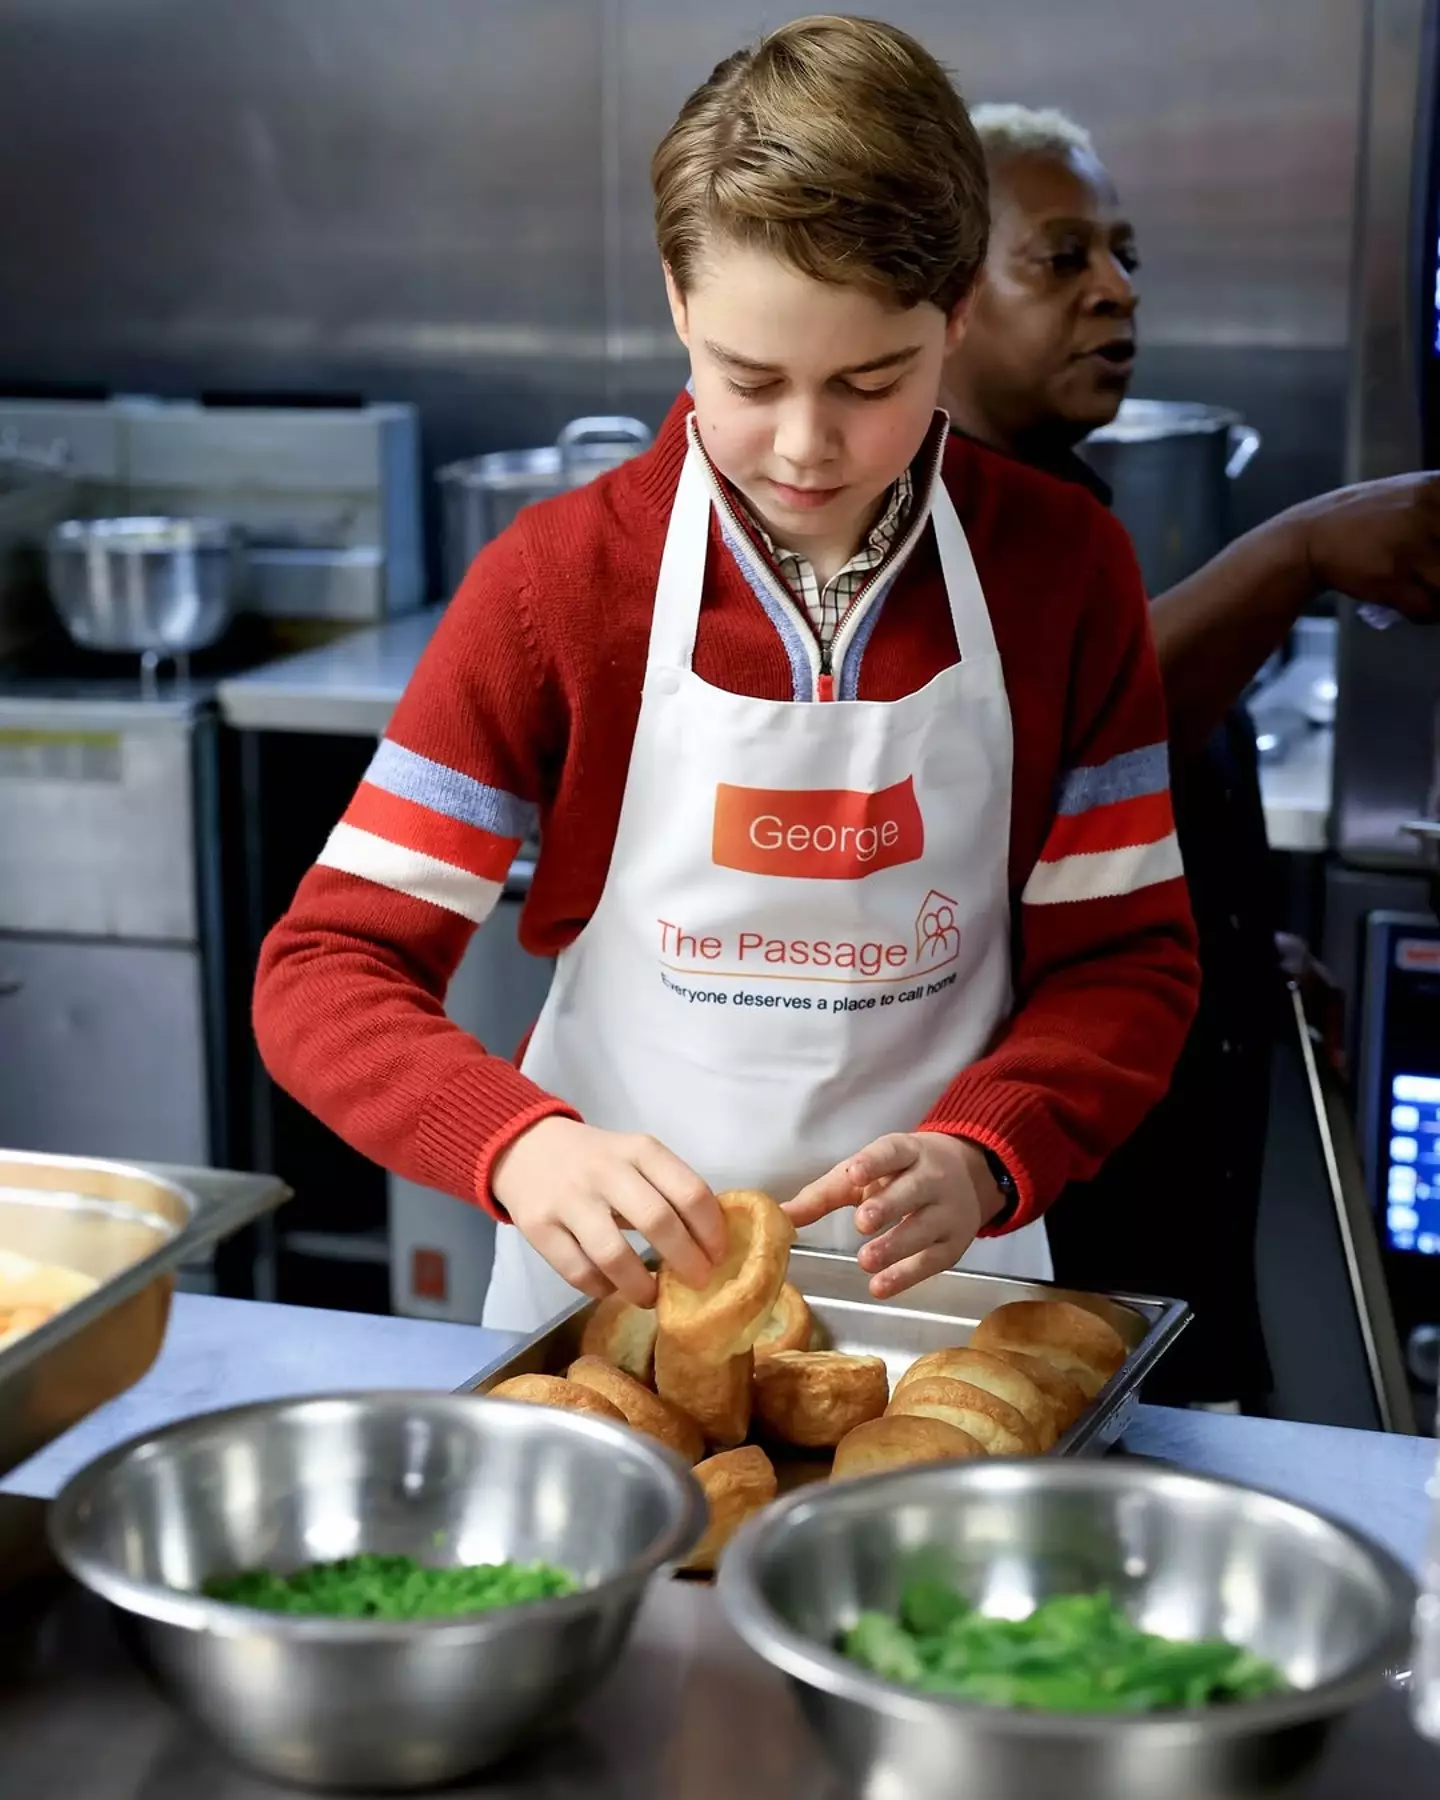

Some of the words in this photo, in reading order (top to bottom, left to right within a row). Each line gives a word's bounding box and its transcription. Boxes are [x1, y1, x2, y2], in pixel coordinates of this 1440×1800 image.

[749, 814, 899, 862] George
[657, 918, 722, 960] The
[738, 932, 908, 976] Passage
[733, 990, 812, 1010] deserves
[817, 998, 828, 1010] a
[833, 997, 876, 1014] place
[880, 994, 894, 1007] to
[898, 986, 924, 1003] call
[926, 972, 957, 996] home
